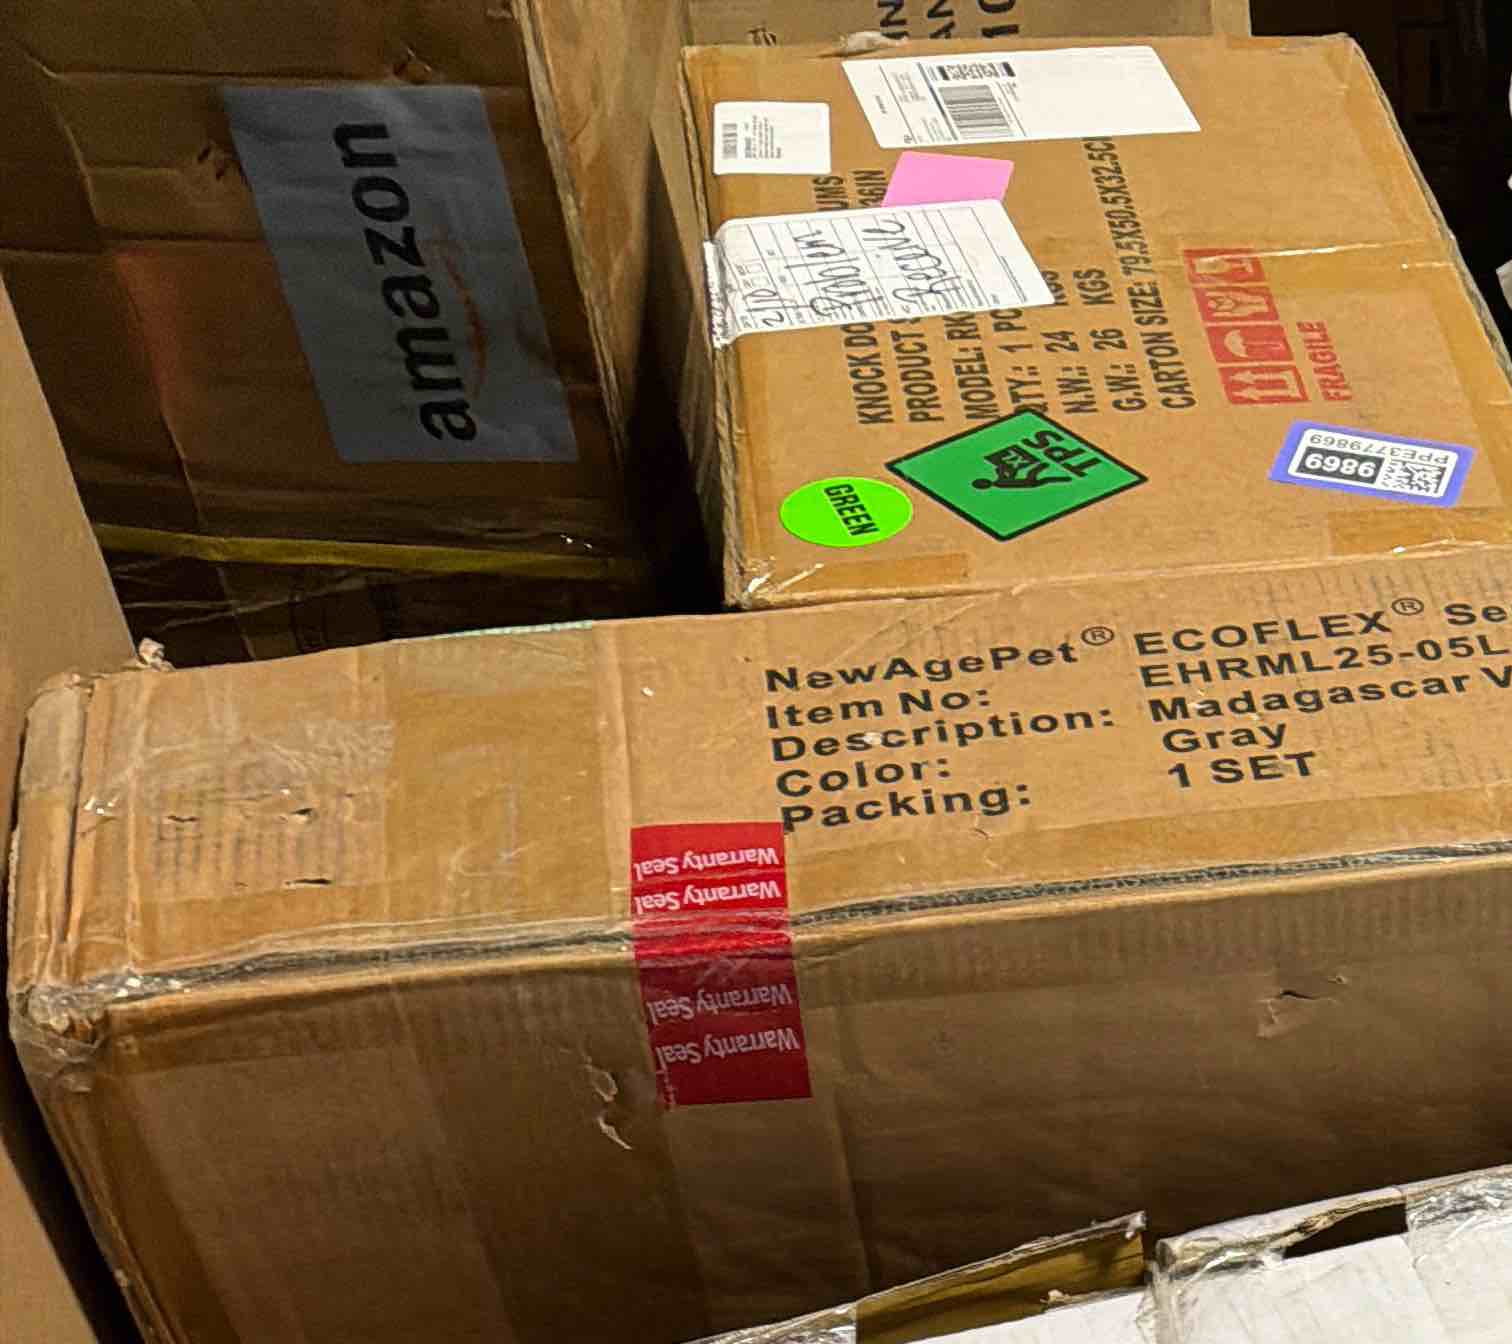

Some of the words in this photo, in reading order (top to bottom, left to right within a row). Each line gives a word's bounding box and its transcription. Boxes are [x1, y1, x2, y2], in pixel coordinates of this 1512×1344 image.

[1082, 137, 1157, 276] 79.5X50.5X32.5C
[333, 124, 477, 441] amazon
[1073, 268, 1115, 305] KGS
[1127, 281, 1169, 326] SIZE:
[840, 322, 879, 348] DO
[1041, 331, 1080, 353] 24
[1089, 328, 1128, 350] 26
[891, 331, 944, 422] PRODUCT
[1140, 332, 1196, 409] CARTON
[1296, 320, 1352, 400] FRAGILE
[846, 353, 895, 425] KNOCK
[952, 347, 1001, 420] MODEL:
[1023, 430, 1102, 478] TPS
[1305, 453, 1376, 478] 9869
[1310, 434, 1449, 464] PPE3779869
[824, 484, 879, 537] GREEN
[767, 697, 884, 729] Item
[900, 686, 989, 716] No:
[1140, 633, 1509, 688] EHRML25-05L
[772, 706, 1114, 762] Description:
[1150, 673, 1483, 724] Madagascar
[776, 757, 951, 799] Color:
[1163, 721, 1287, 755] Gray
[782, 783, 1031, 835] Packing:
[1167, 762, 1190, 789] 1
[1211, 751, 1317, 784] SET
[634, 857, 680, 880] Seal
[682, 848, 779, 870] Warranty
[634, 891, 681, 914] Seal
[683, 880, 781, 906] Warranty
[647, 997, 695, 1024] Seal
[697, 984, 793, 1015] Warranty
[656, 1043, 701, 1071] Seal
[703, 1028, 800, 1059] Warranty
